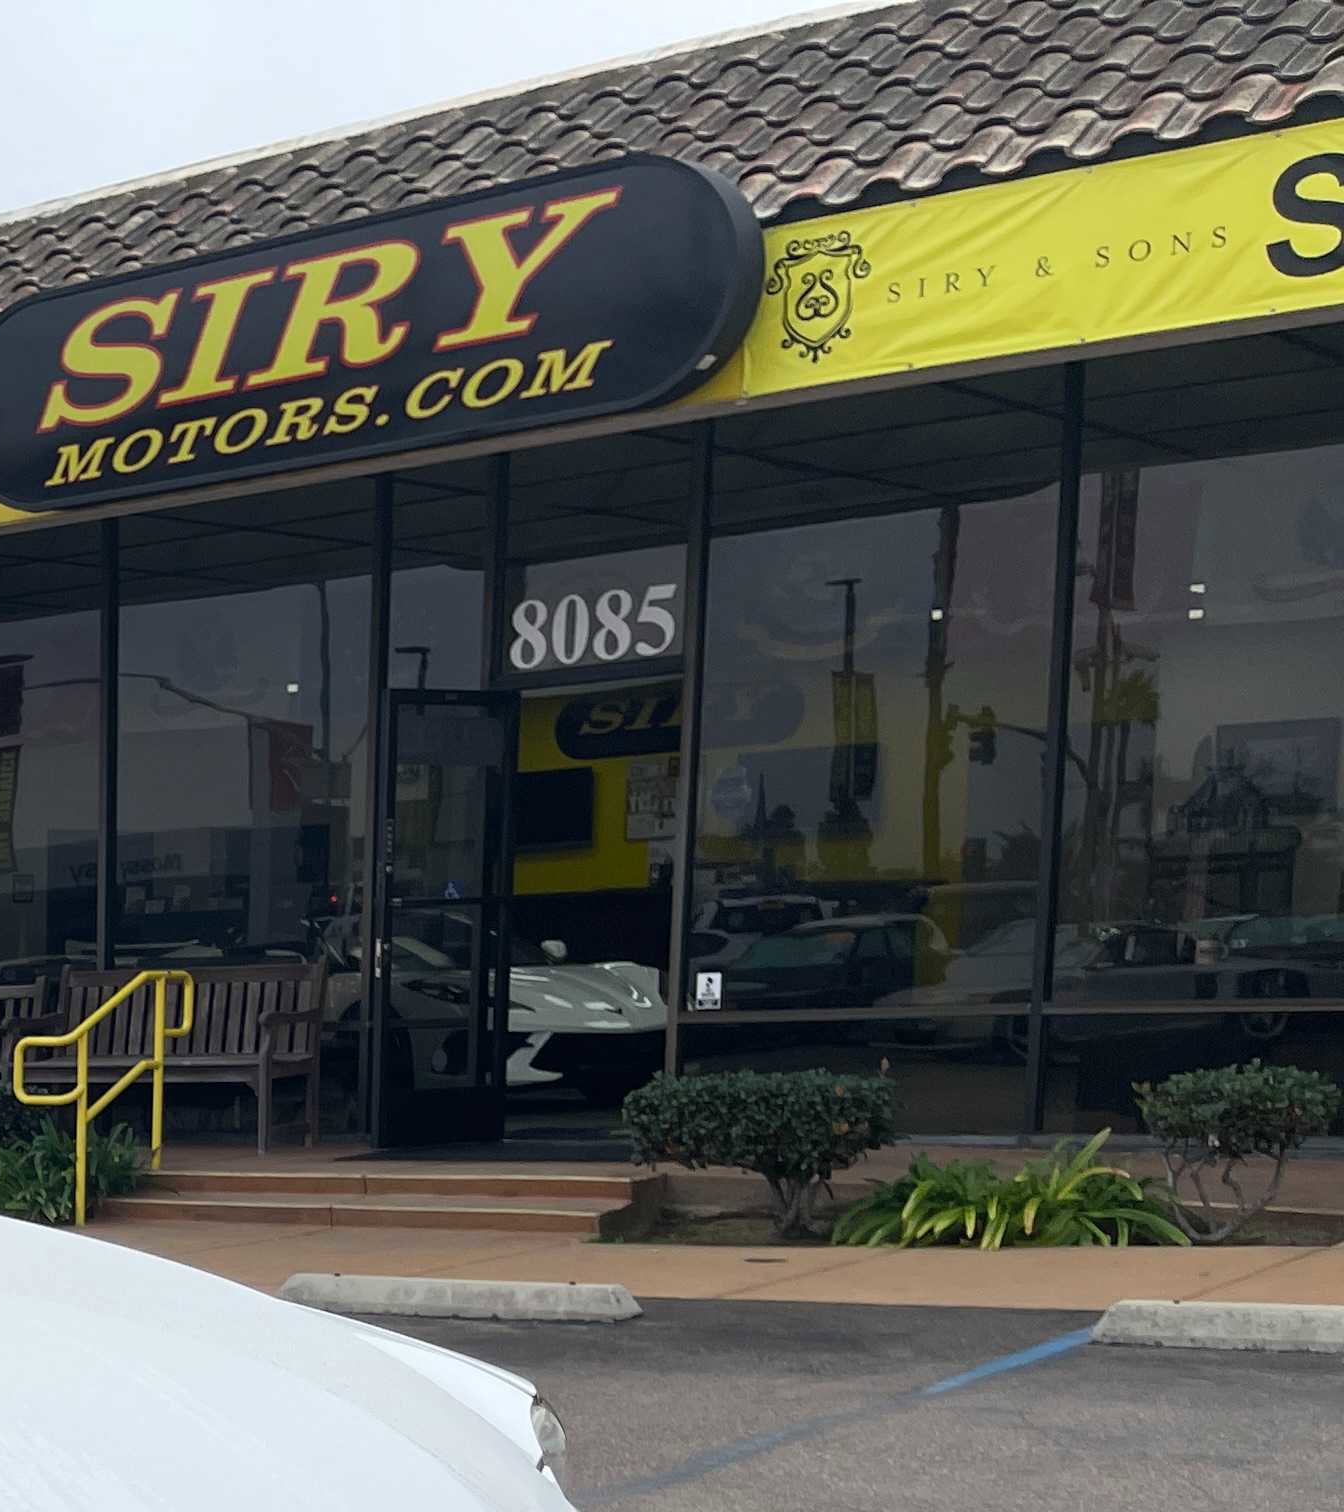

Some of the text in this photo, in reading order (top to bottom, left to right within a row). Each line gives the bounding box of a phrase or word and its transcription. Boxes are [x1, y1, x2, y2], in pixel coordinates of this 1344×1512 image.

[37, 187, 624, 434] SIRY
[887, 225, 1230, 304] SIRY & SONS
[44, 339, 615, 488] MOTORS.COM
[509, 582, 676, 672] 8085
